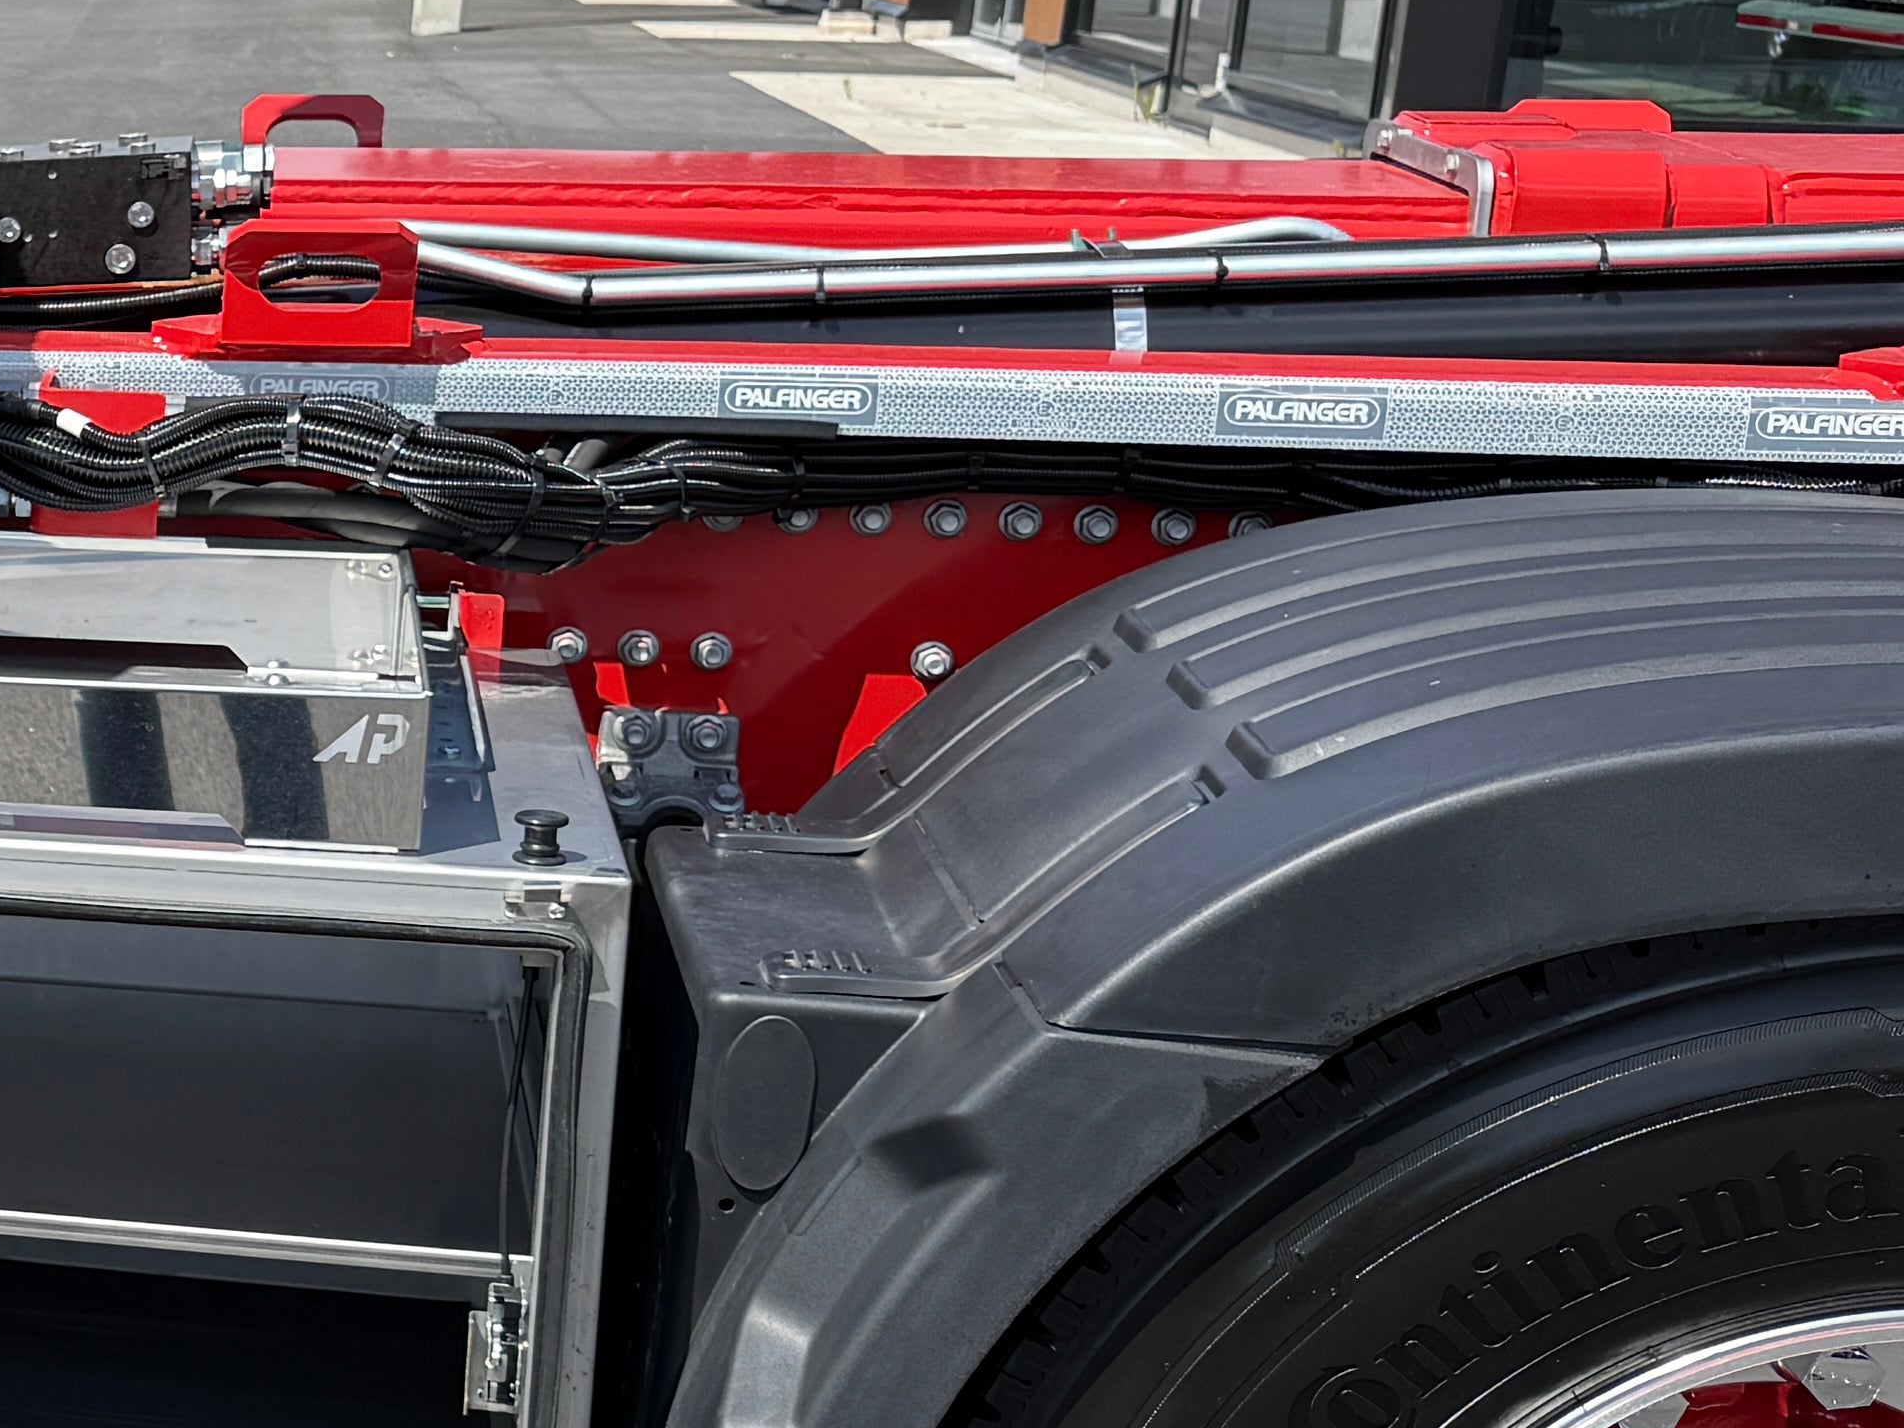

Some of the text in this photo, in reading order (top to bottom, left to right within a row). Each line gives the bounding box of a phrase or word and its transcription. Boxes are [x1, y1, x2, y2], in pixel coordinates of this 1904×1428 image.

[259, 377, 380, 399] PALFINGER
[734, 386, 863, 410] PALFINGER
[1234, 399, 1370, 424] PALFINGER
[1766, 412, 1904, 437] PALFINGER
[312, 713, 411, 764] AP
